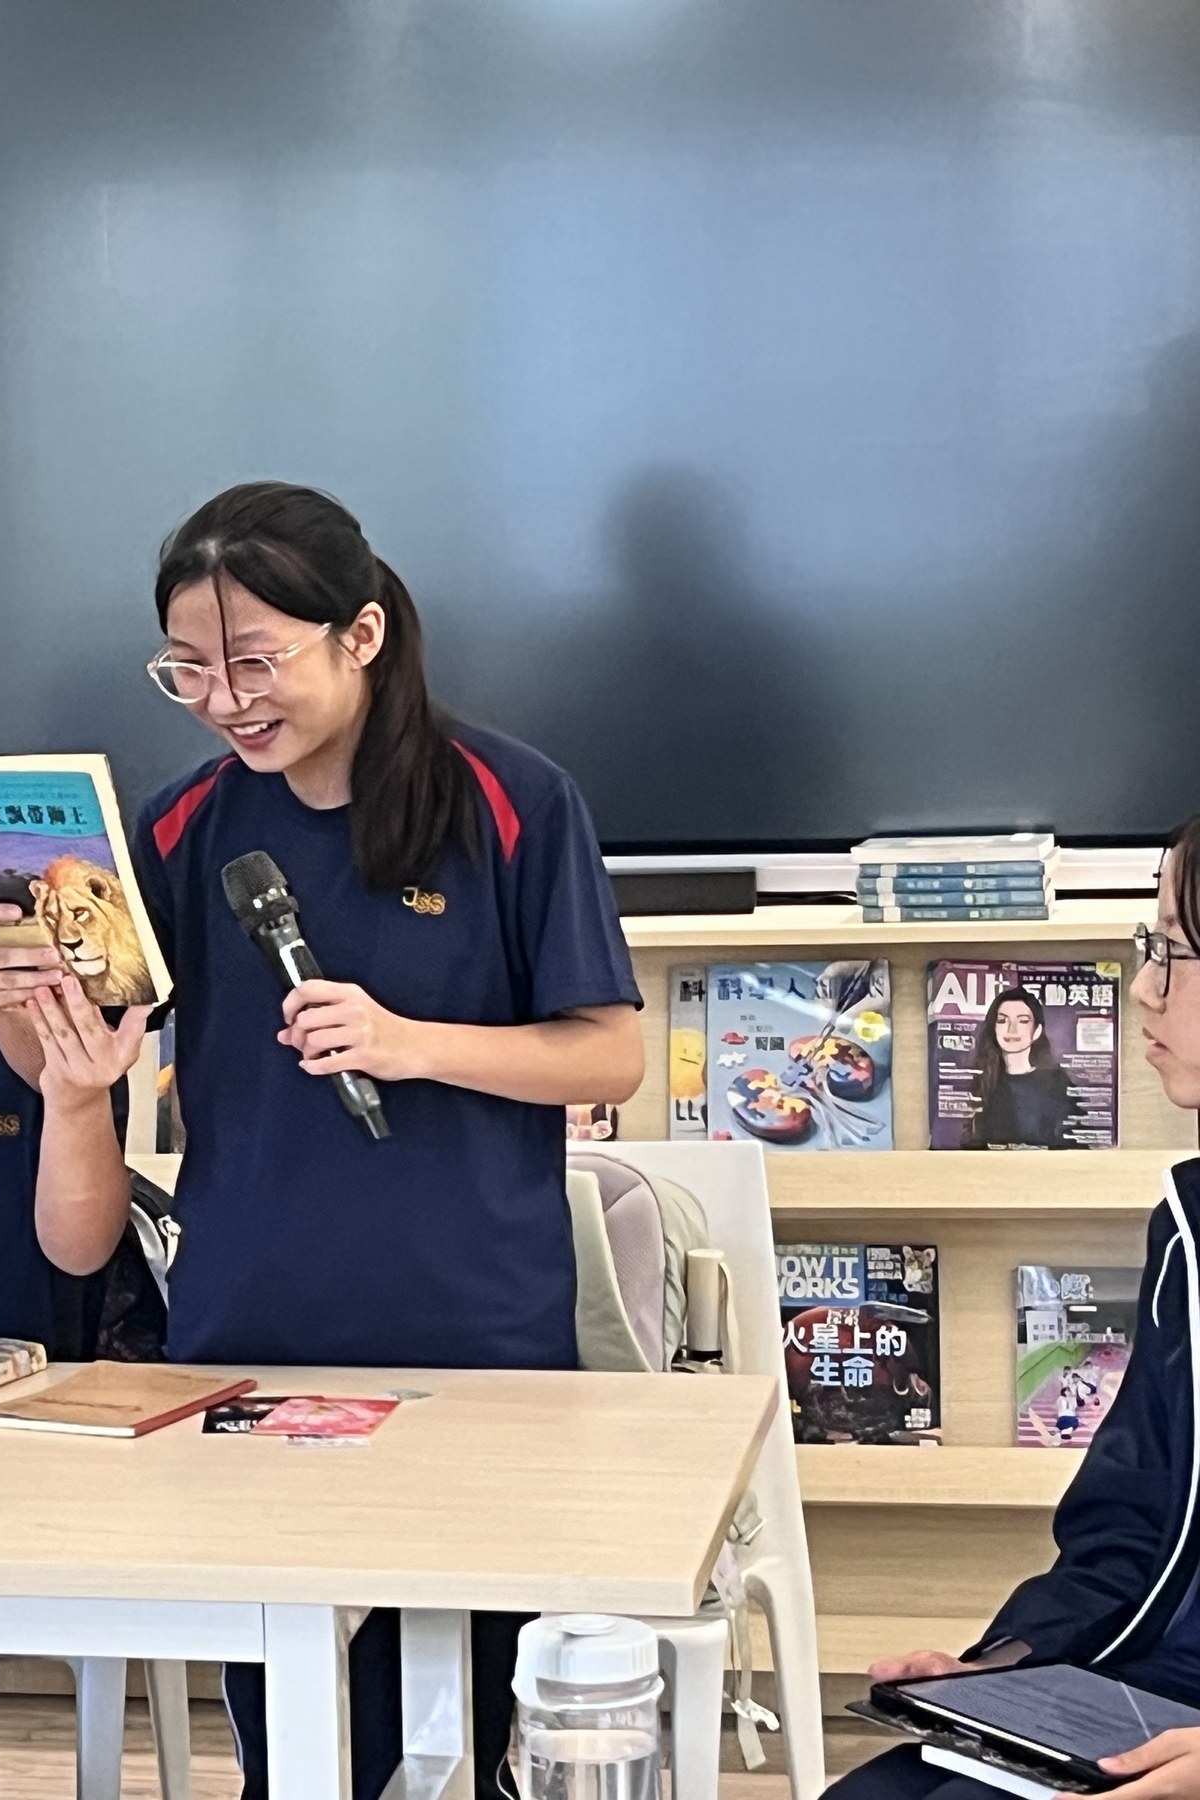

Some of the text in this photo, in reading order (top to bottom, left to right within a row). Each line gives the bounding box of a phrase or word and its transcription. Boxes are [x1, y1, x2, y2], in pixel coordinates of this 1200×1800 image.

[832, 1256, 859, 1279] IT
[782, 1321, 907, 1357] 火星上的
[810, 1354, 875, 1388] 生命
